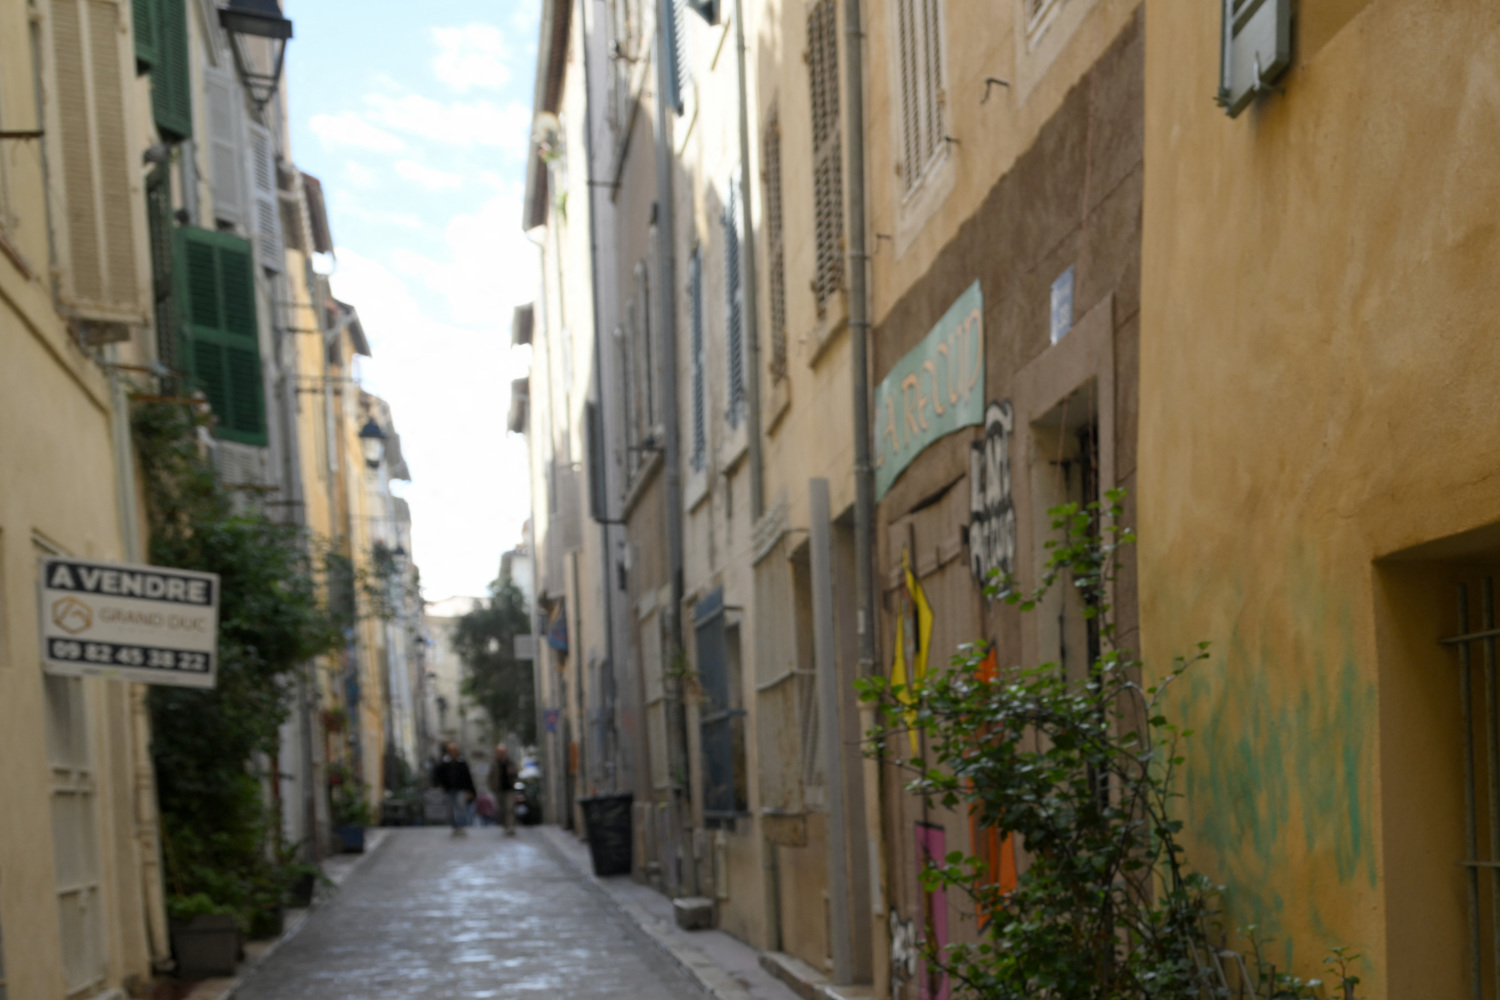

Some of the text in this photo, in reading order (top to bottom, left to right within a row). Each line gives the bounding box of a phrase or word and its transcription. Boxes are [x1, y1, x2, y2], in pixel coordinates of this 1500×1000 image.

[51, 564, 208, 603] A VENDRE
[99, 607, 164, 626] GRAND
[167, 615, 205, 632] DUC
[52, 639, 82, 660] 09
[84, 643, 113, 664] 82
[115, 647, 144, 668] 45
[177, 653, 206, 672] 22
